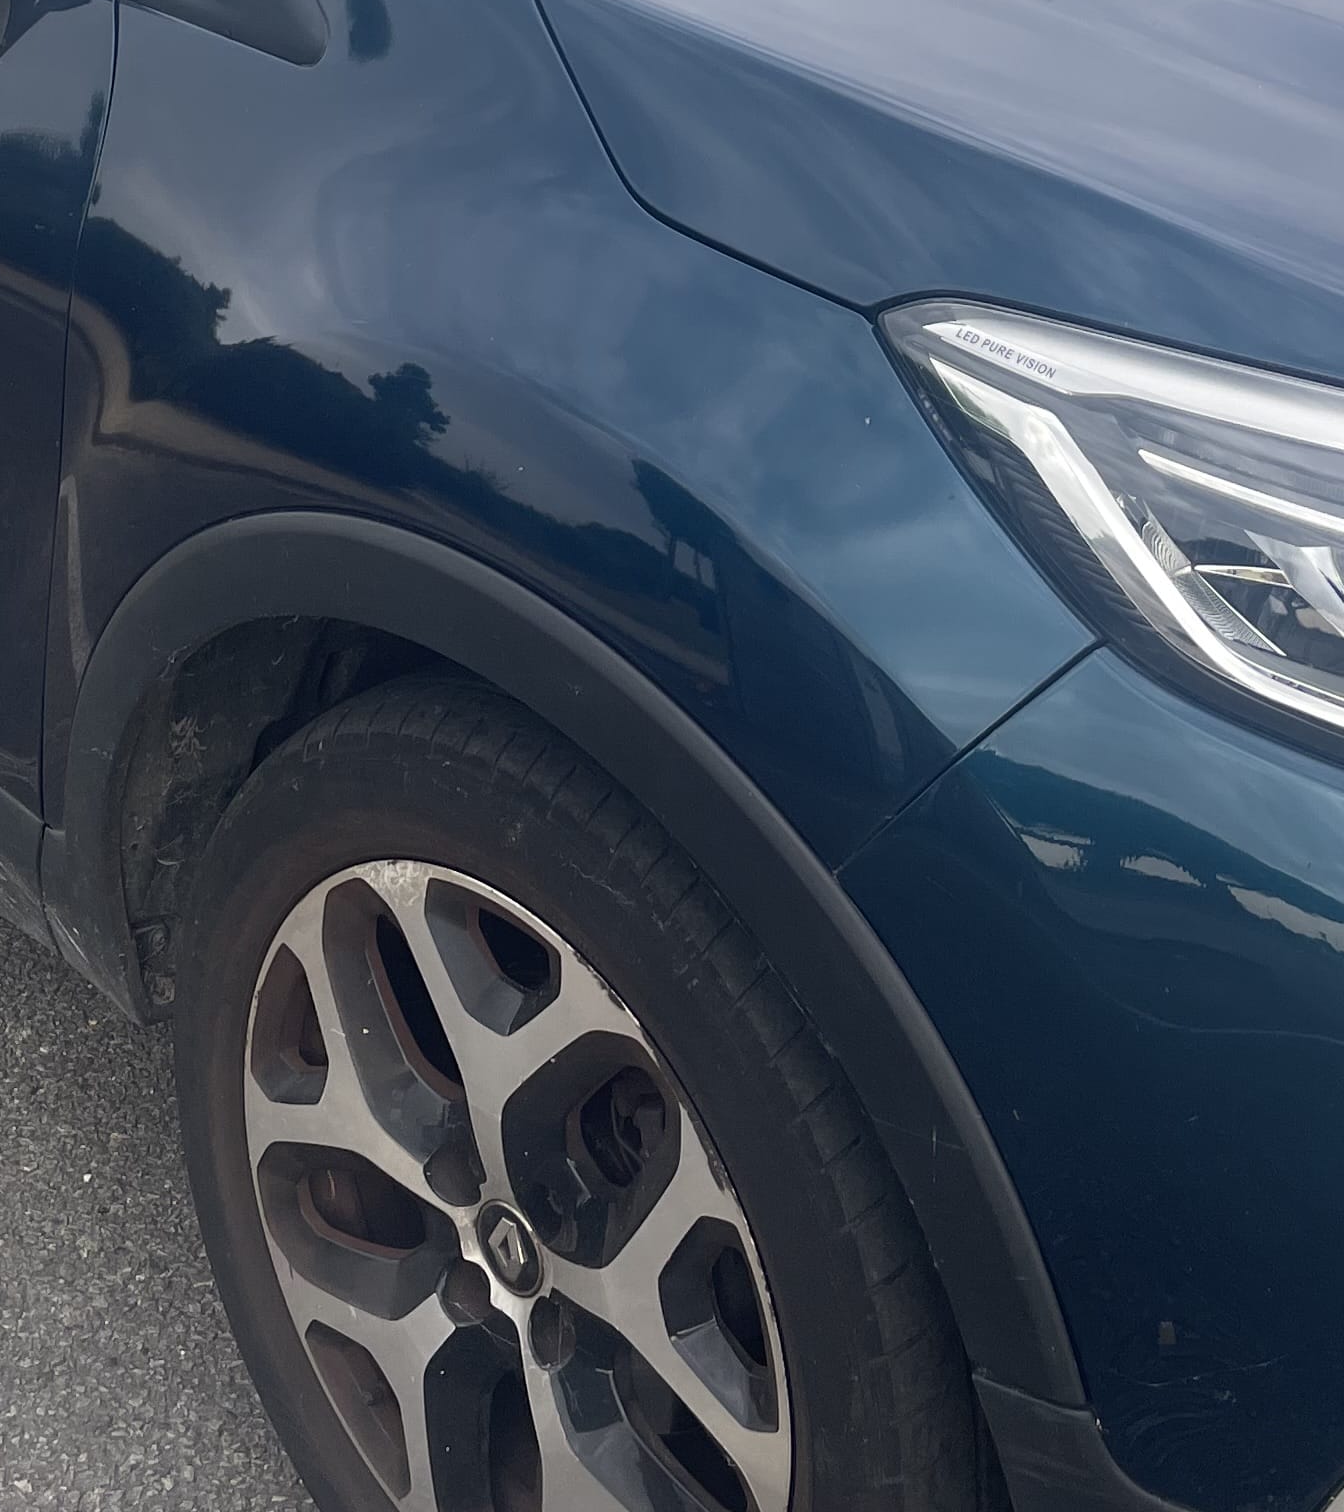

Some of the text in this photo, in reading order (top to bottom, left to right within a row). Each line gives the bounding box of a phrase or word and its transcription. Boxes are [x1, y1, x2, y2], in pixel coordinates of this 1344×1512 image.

[956, 328, 1057, 379] LED PURE VISION
